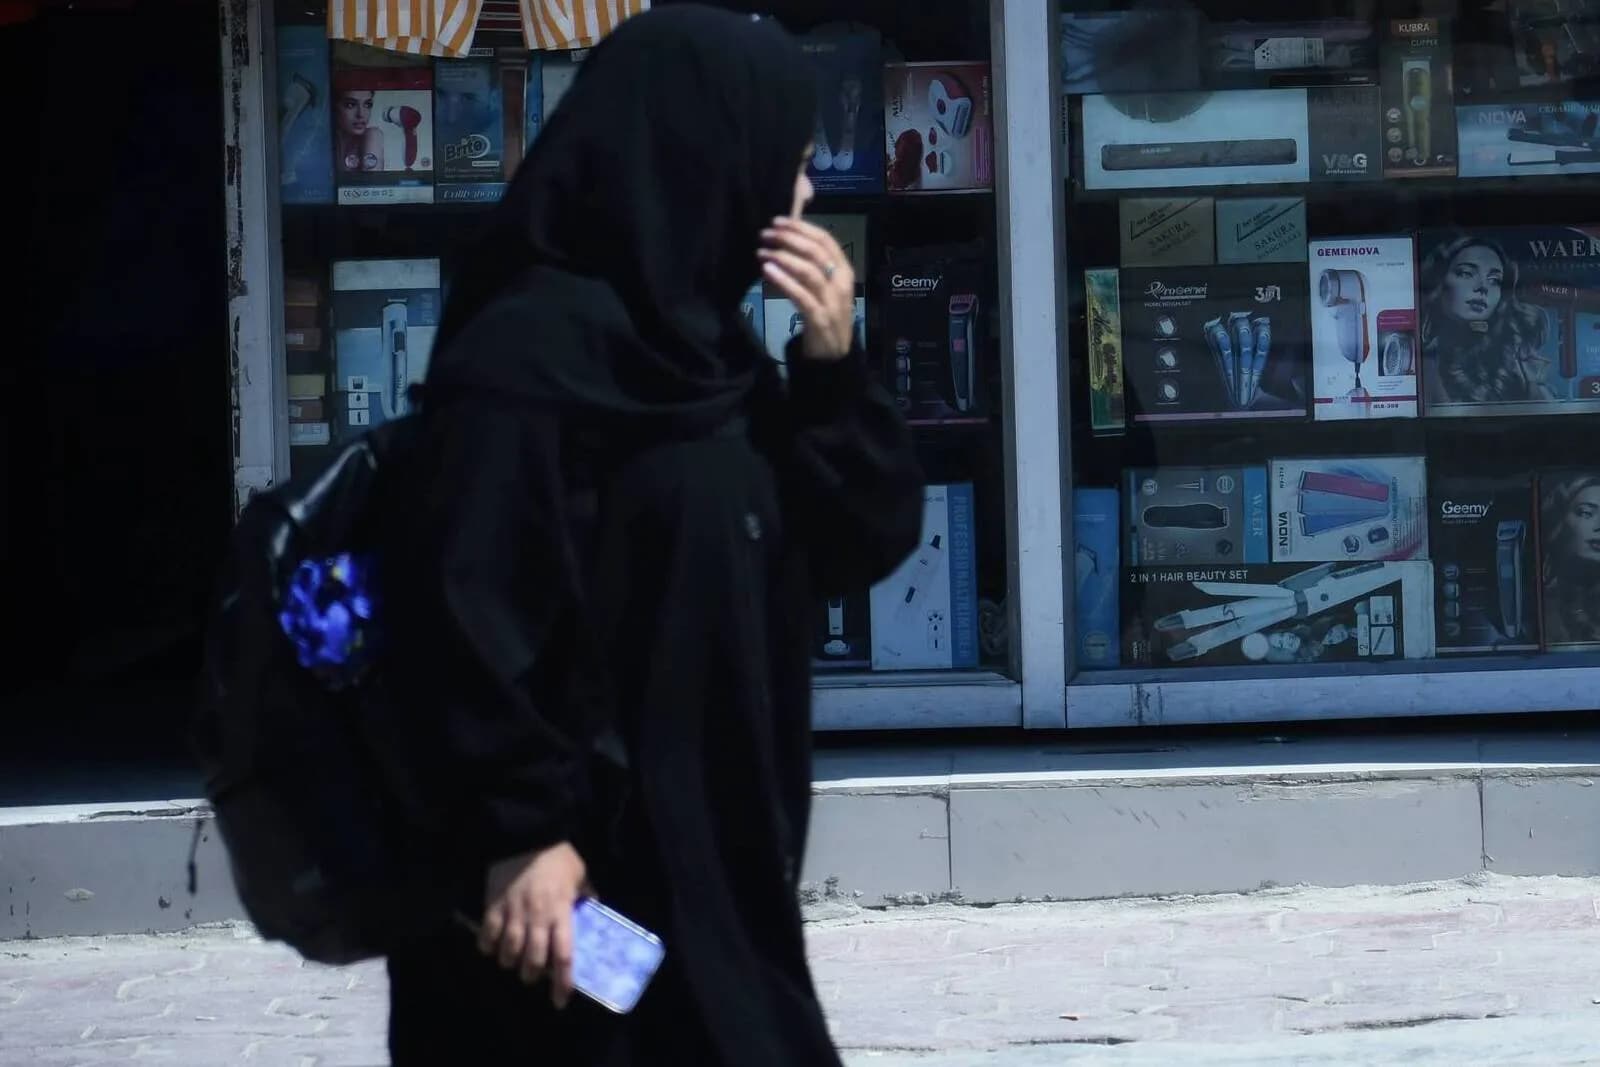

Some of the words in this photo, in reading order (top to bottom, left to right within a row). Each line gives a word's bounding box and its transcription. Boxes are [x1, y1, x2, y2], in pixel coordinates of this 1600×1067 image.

[1398, 23, 1430, 33] KUBRA
[1479, 110, 1527, 124] NOVA
[1255, 221, 1296, 250] SAKURA
[1317, 247, 1380, 257] GEMEINOVA
[891, 274, 939, 291] Geemy
[1441, 501, 1489, 517] Geemy
[1278, 511, 1288, 546] NOVA
[1130, 574, 1136, 583] 2
[1139, 573, 1149, 583] IN
[1160, 572, 1184, 582] HAIR
[1187, 571, 1226, 581] BEAUTY
[1229, 570, 1248, 580] SET
